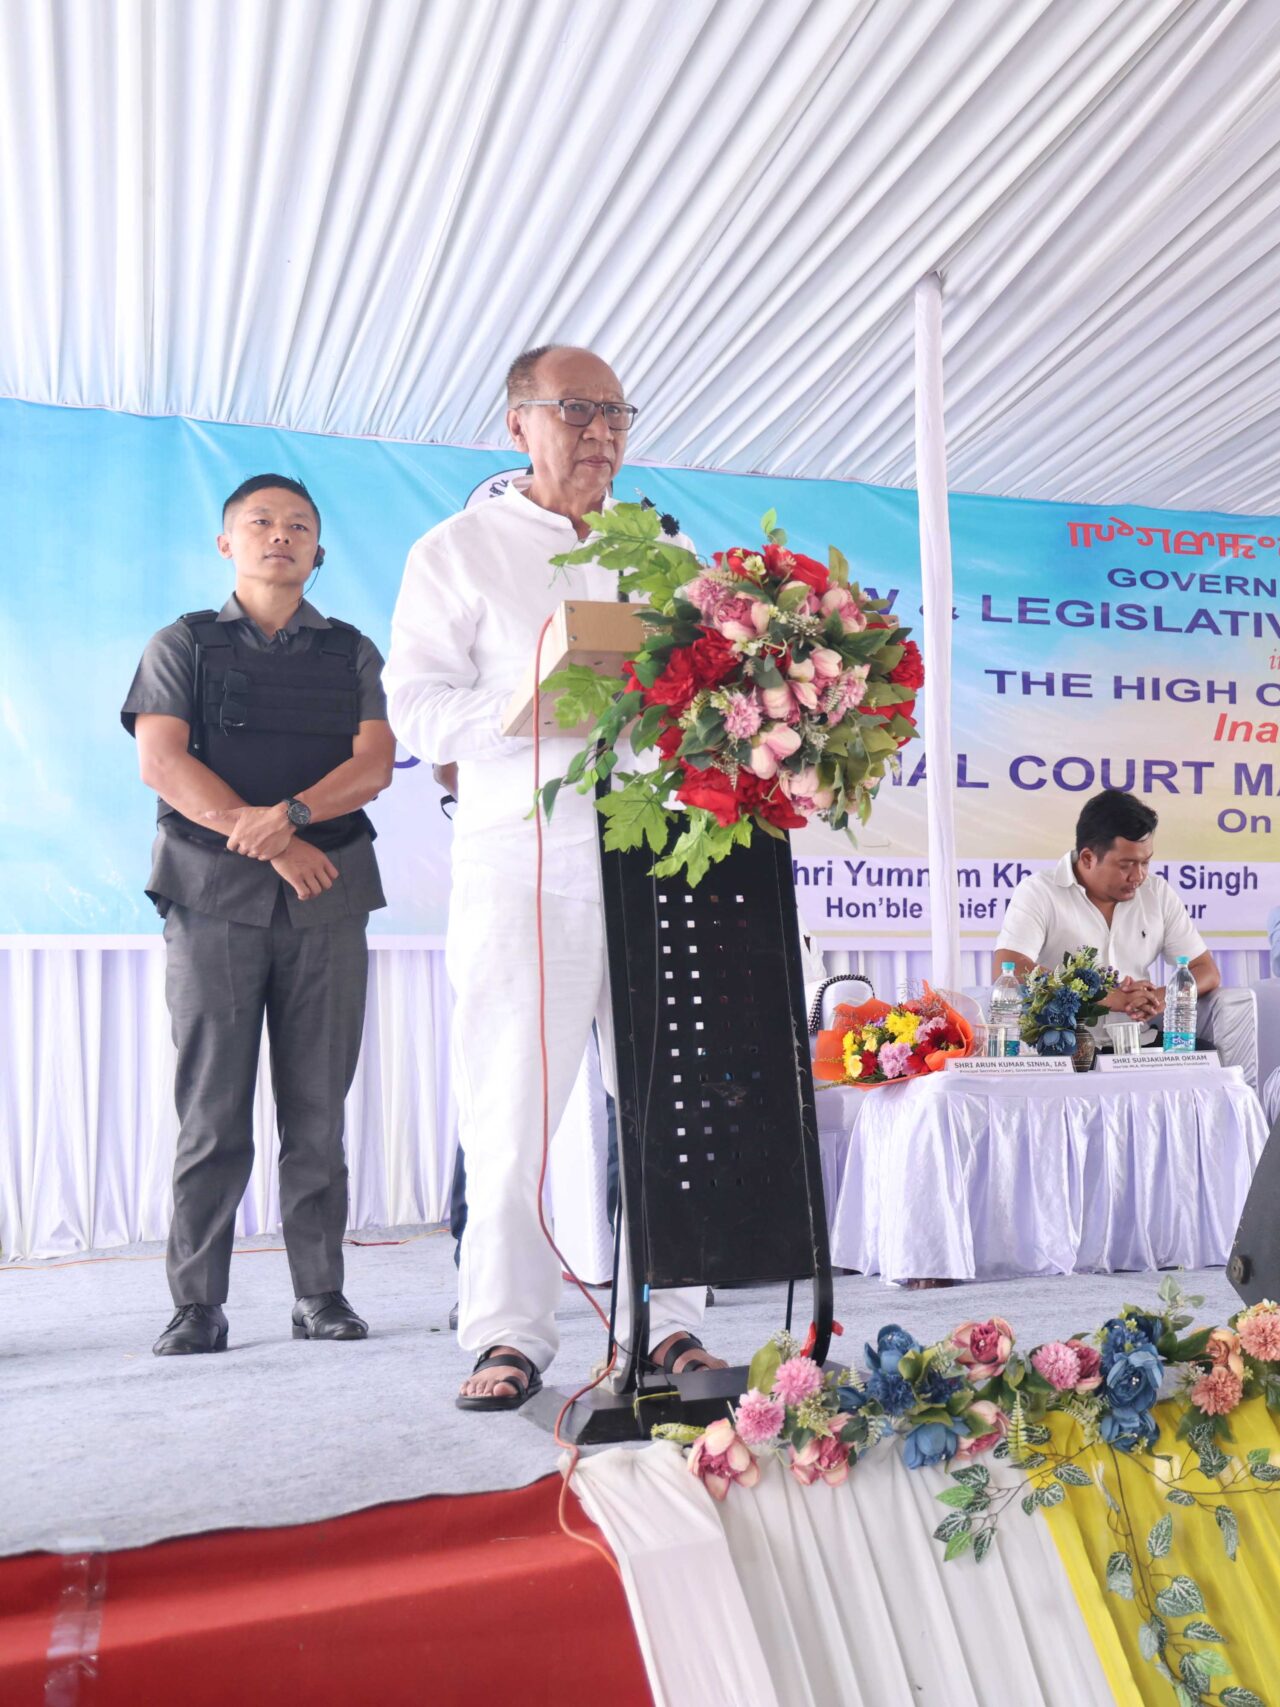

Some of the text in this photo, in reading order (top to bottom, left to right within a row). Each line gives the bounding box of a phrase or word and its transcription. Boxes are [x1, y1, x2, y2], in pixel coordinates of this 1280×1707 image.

[985, 669, 1093, 698] THE
[1113, 675, 1237, 704] HIGH
[1009, 755, 1215, 797] COURT
[1217, 808, 1271, 834] On
[792, 860, 833, 886] hri
[844, 861, 981, 888] Yumnm
[1179, 865, 1258, 897] Singh
